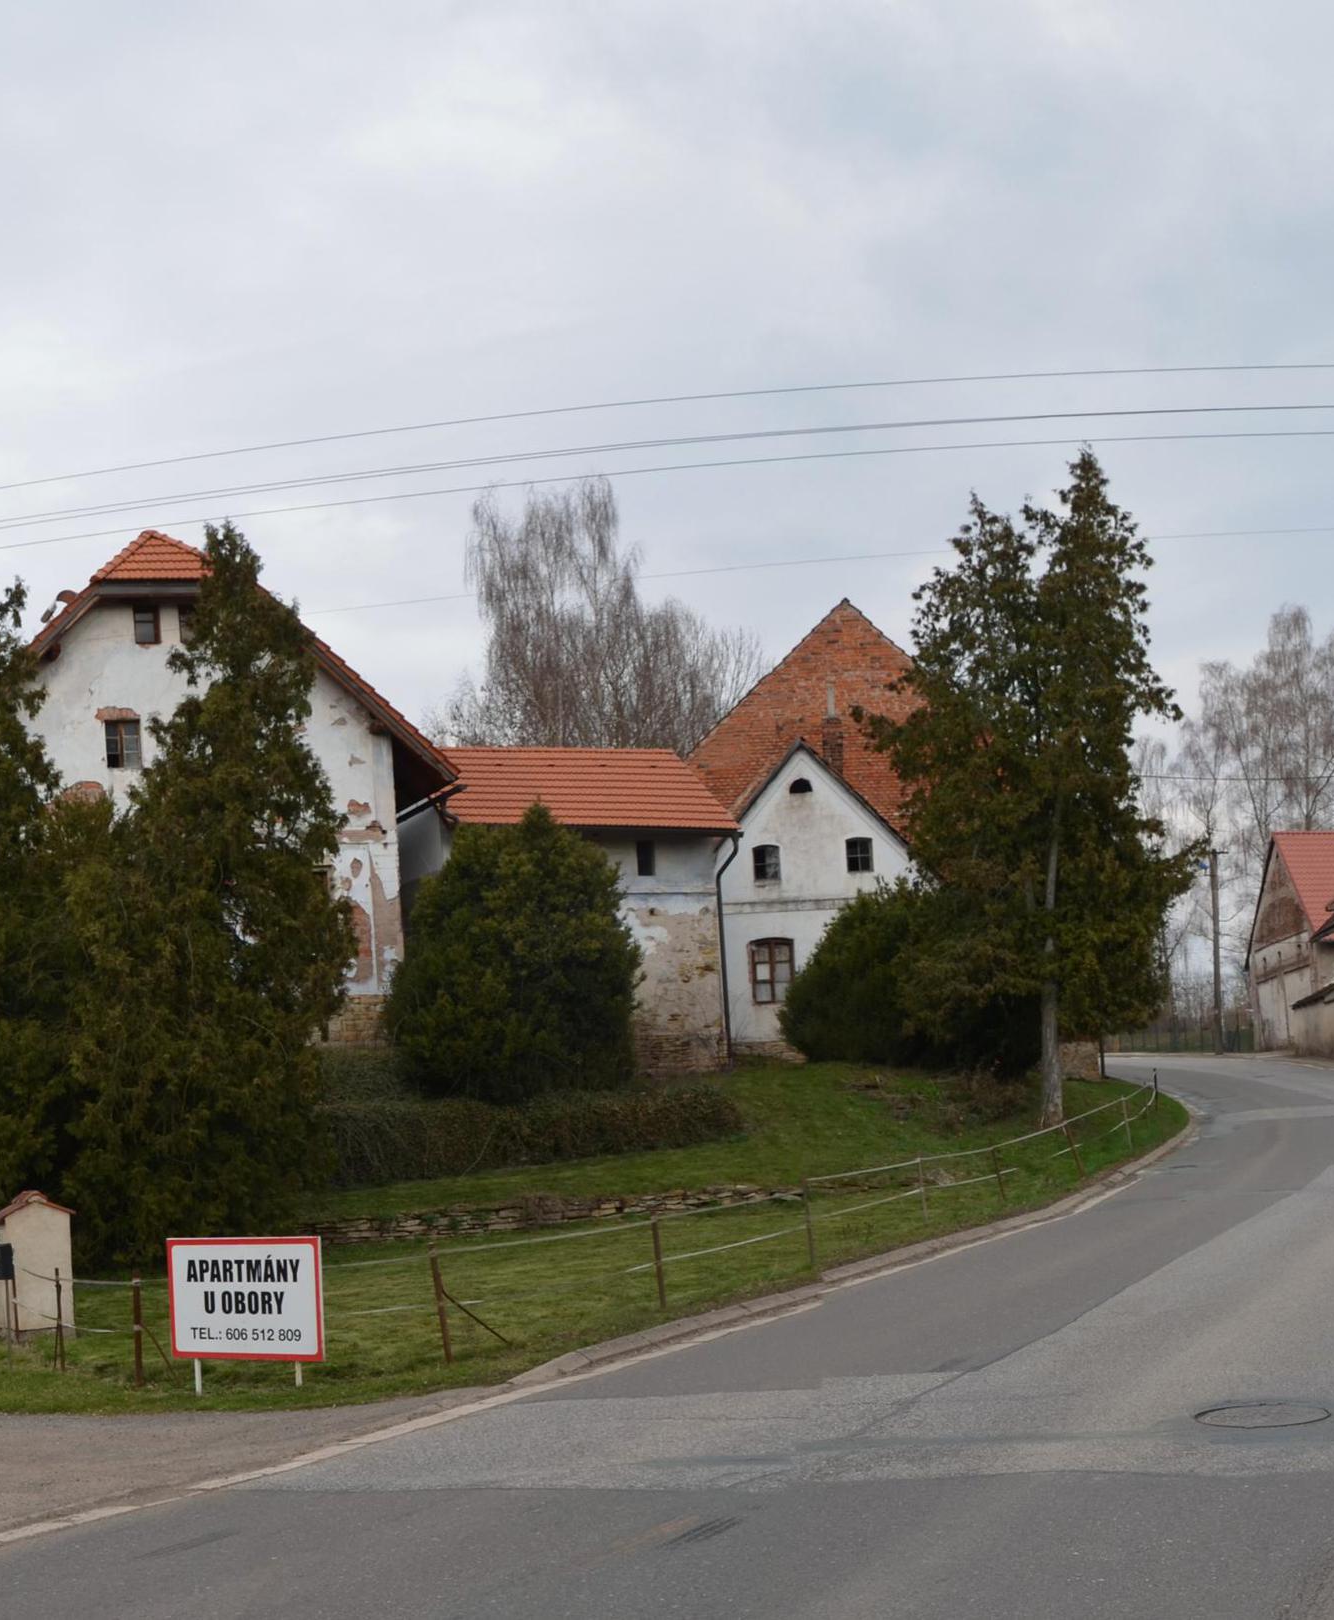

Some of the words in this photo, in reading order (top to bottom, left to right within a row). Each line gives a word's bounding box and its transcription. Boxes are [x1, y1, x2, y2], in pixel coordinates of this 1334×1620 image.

[186, 1254, 300, 1283] APARTMÁNY
[203, 1291, 216, 1315] U
[221, 1290, 285, 1315] OBORY
[190, 1327, 223, 1341] TEL.:
[225, 1328, 249, 1341] 606
[251, 1328, 275, 1342] 512
[278, 1328, 302, 1342] 809
